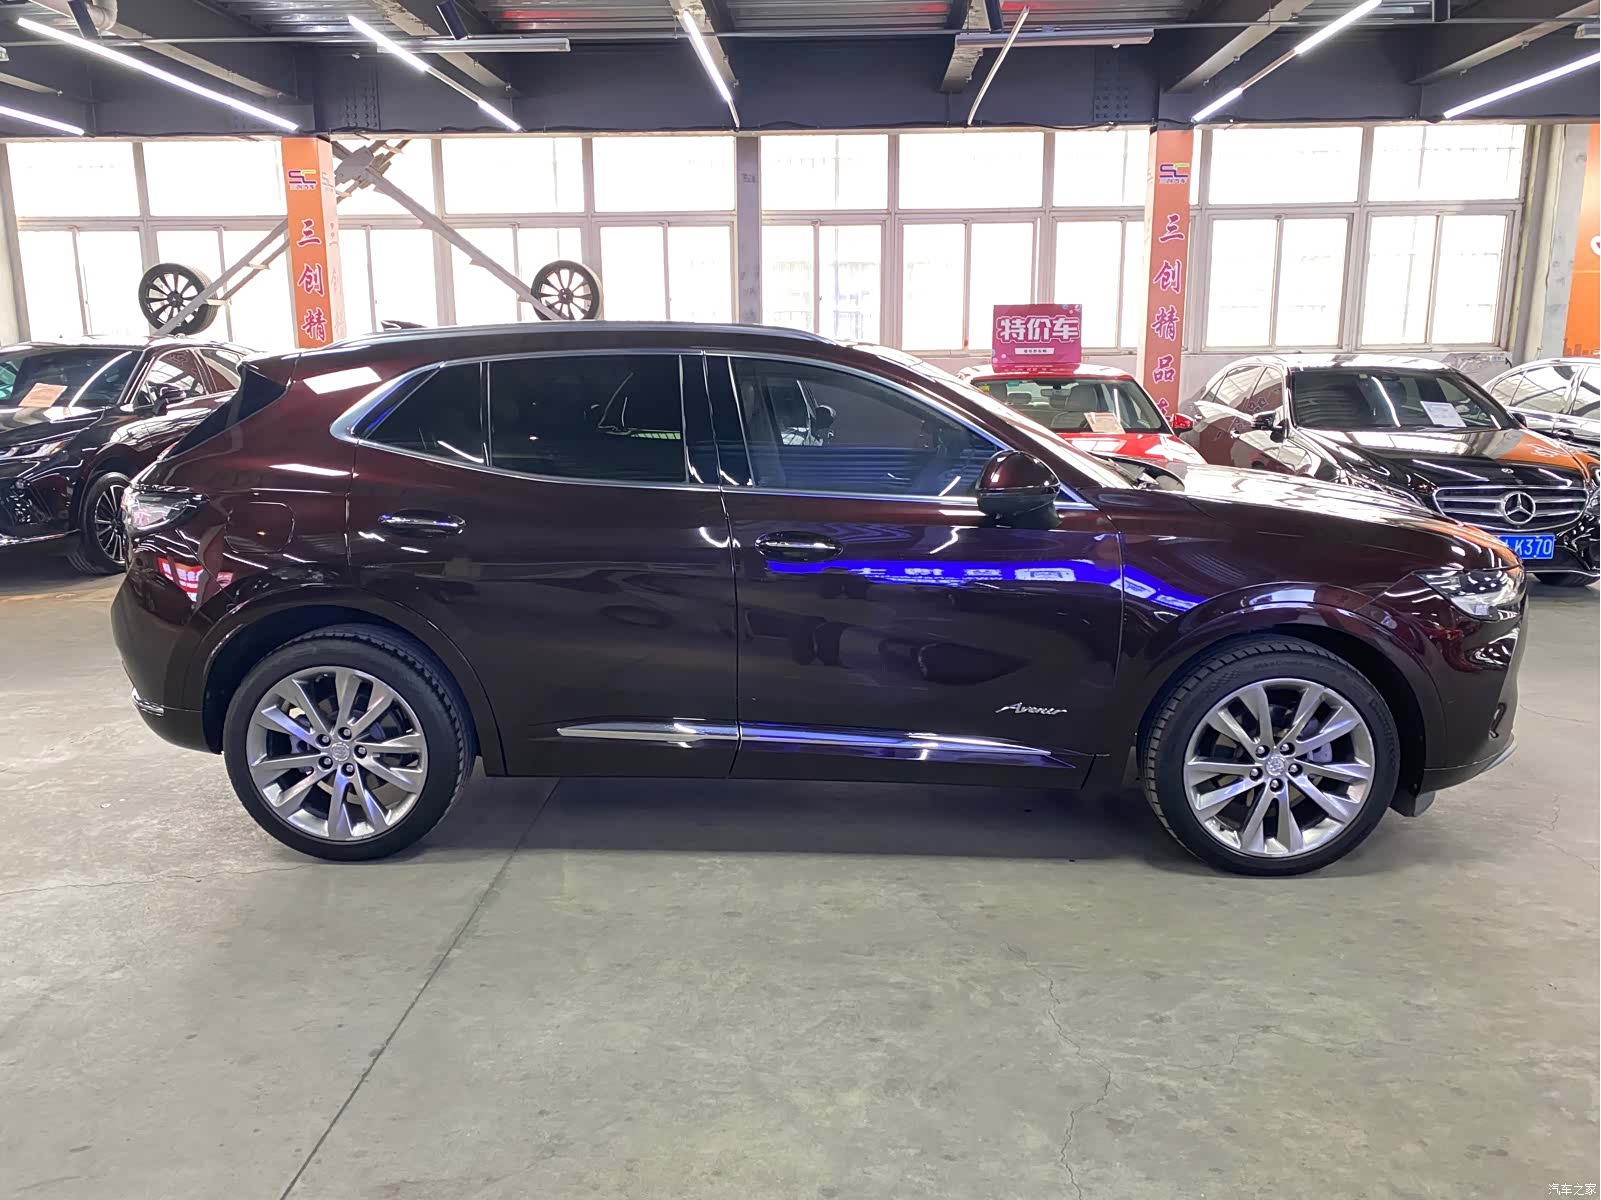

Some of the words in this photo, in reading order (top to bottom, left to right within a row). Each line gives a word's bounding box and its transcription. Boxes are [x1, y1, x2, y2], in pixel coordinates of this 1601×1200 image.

[297, 218, 328, 342] 三创精
[1000, 317, 1079, 341] 特价车
